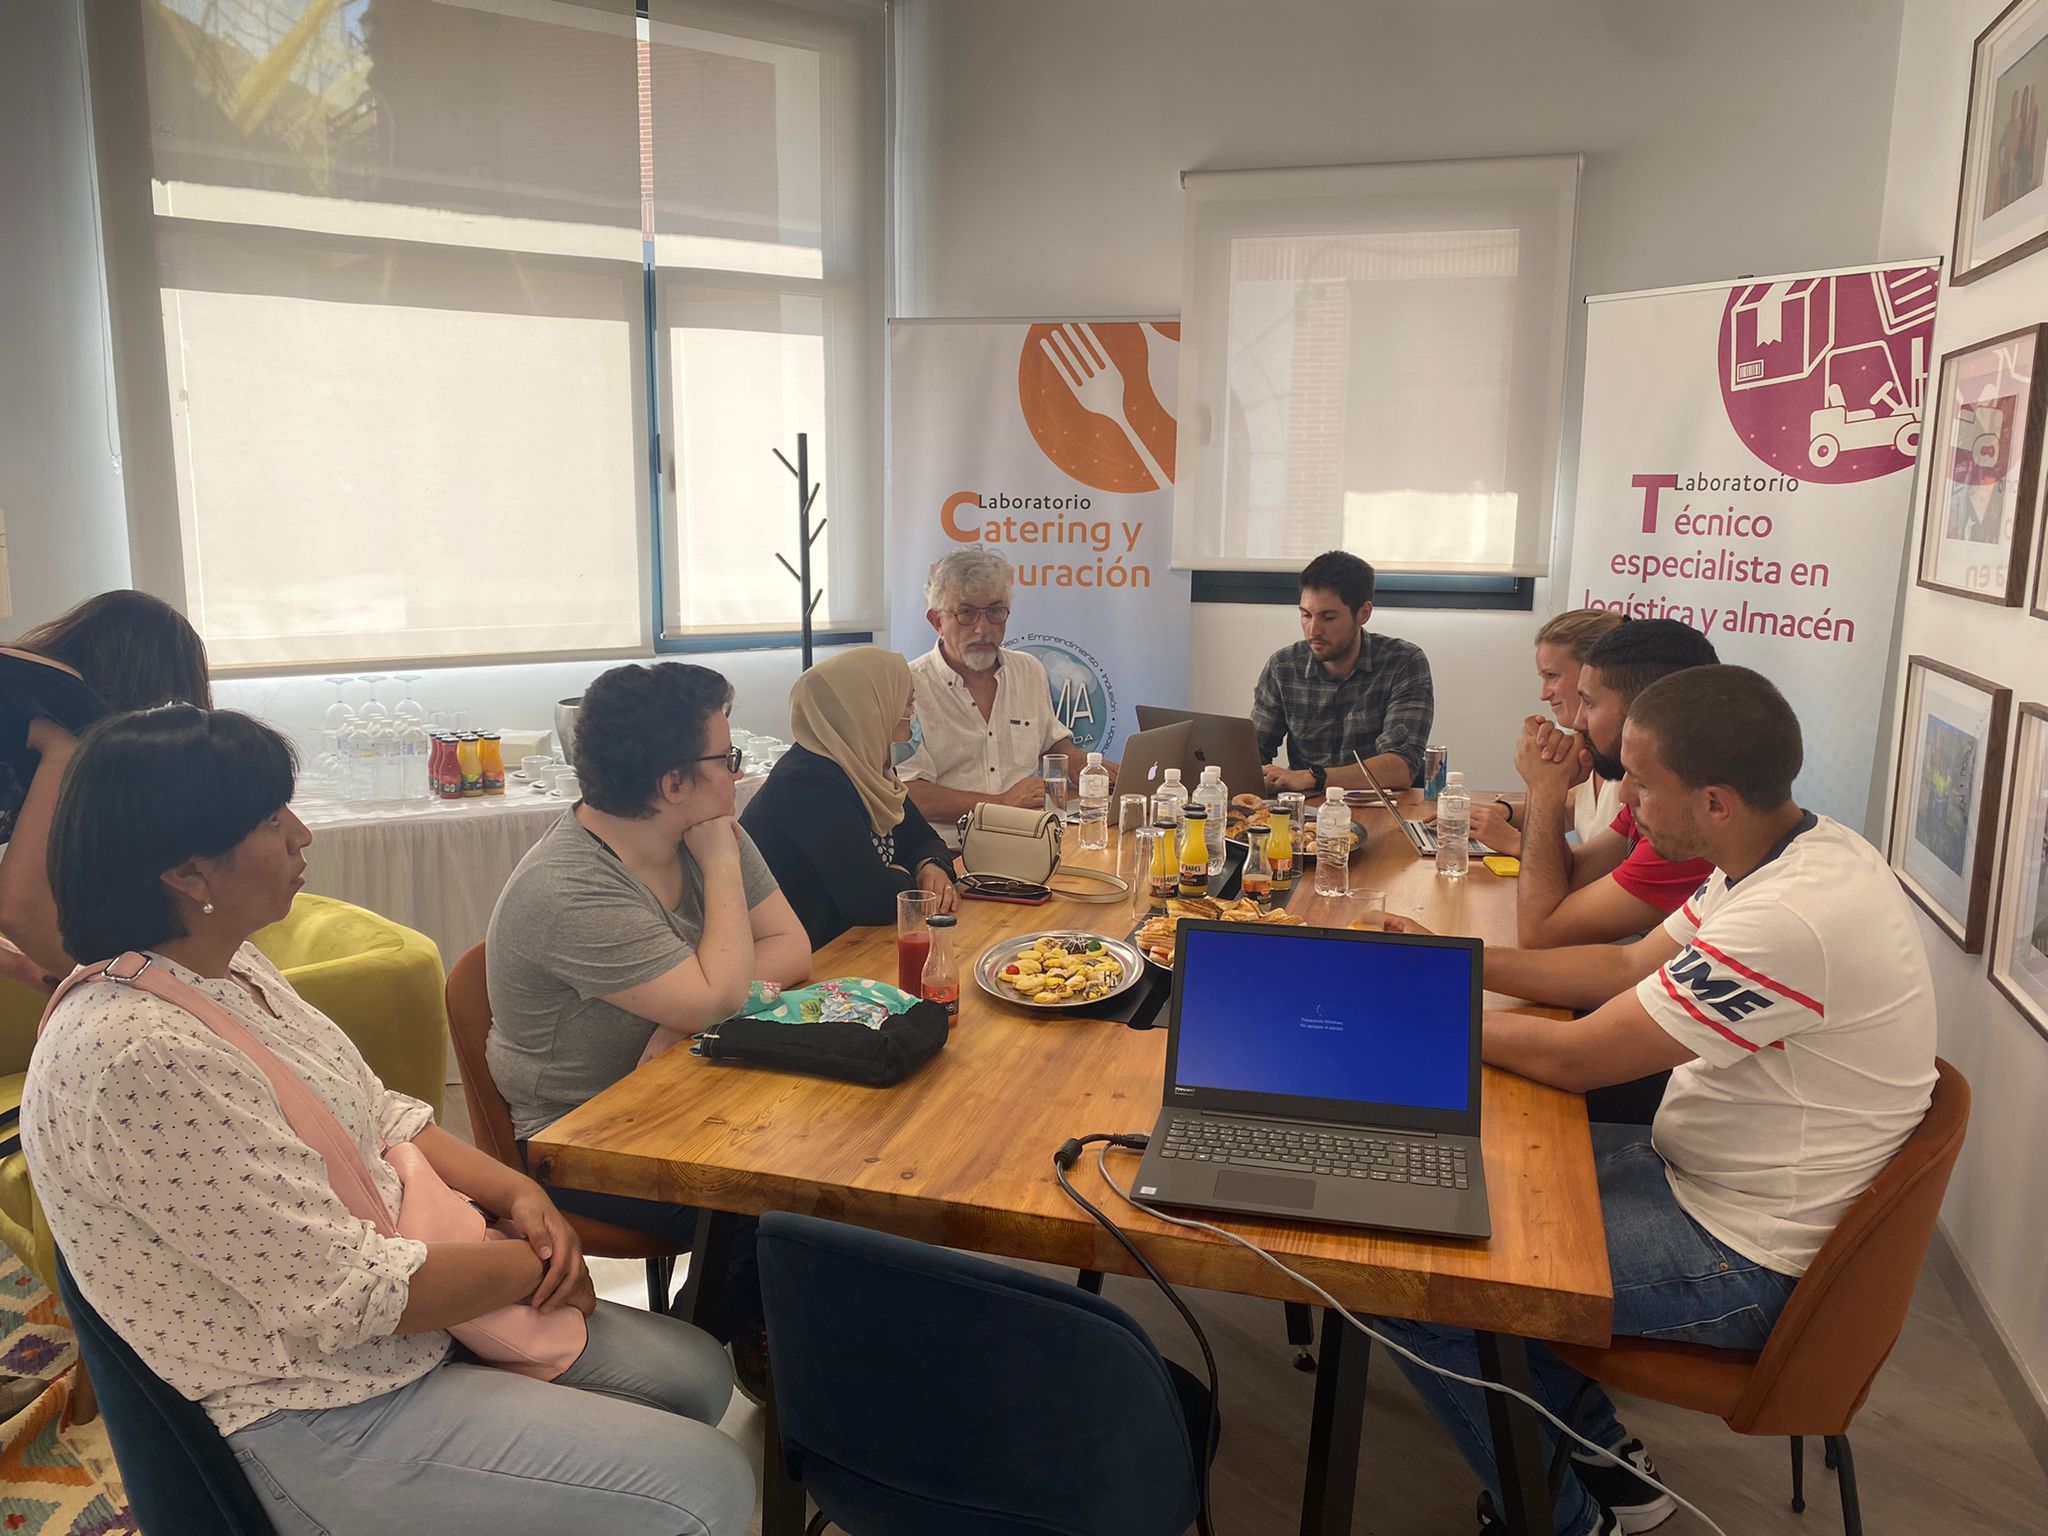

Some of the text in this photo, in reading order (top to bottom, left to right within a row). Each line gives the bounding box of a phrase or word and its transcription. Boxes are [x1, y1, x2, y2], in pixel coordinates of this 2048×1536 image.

[1674, 472, 1799, 492] Laboratorio
[979, 493, 1092, 510] Laboratorio
[1631, 474, 1773, 538] Técnico
[940, 491, 1144, 552] Catering y
[1009, 555, 1151, 588] uración
[1610, 549, 1830, 587] especialista en
[1700, 607, 1719, 637] y
[1722, 600, 1856, 642] almacén
[1027, 633, 1099, 668] Emprendimiento
